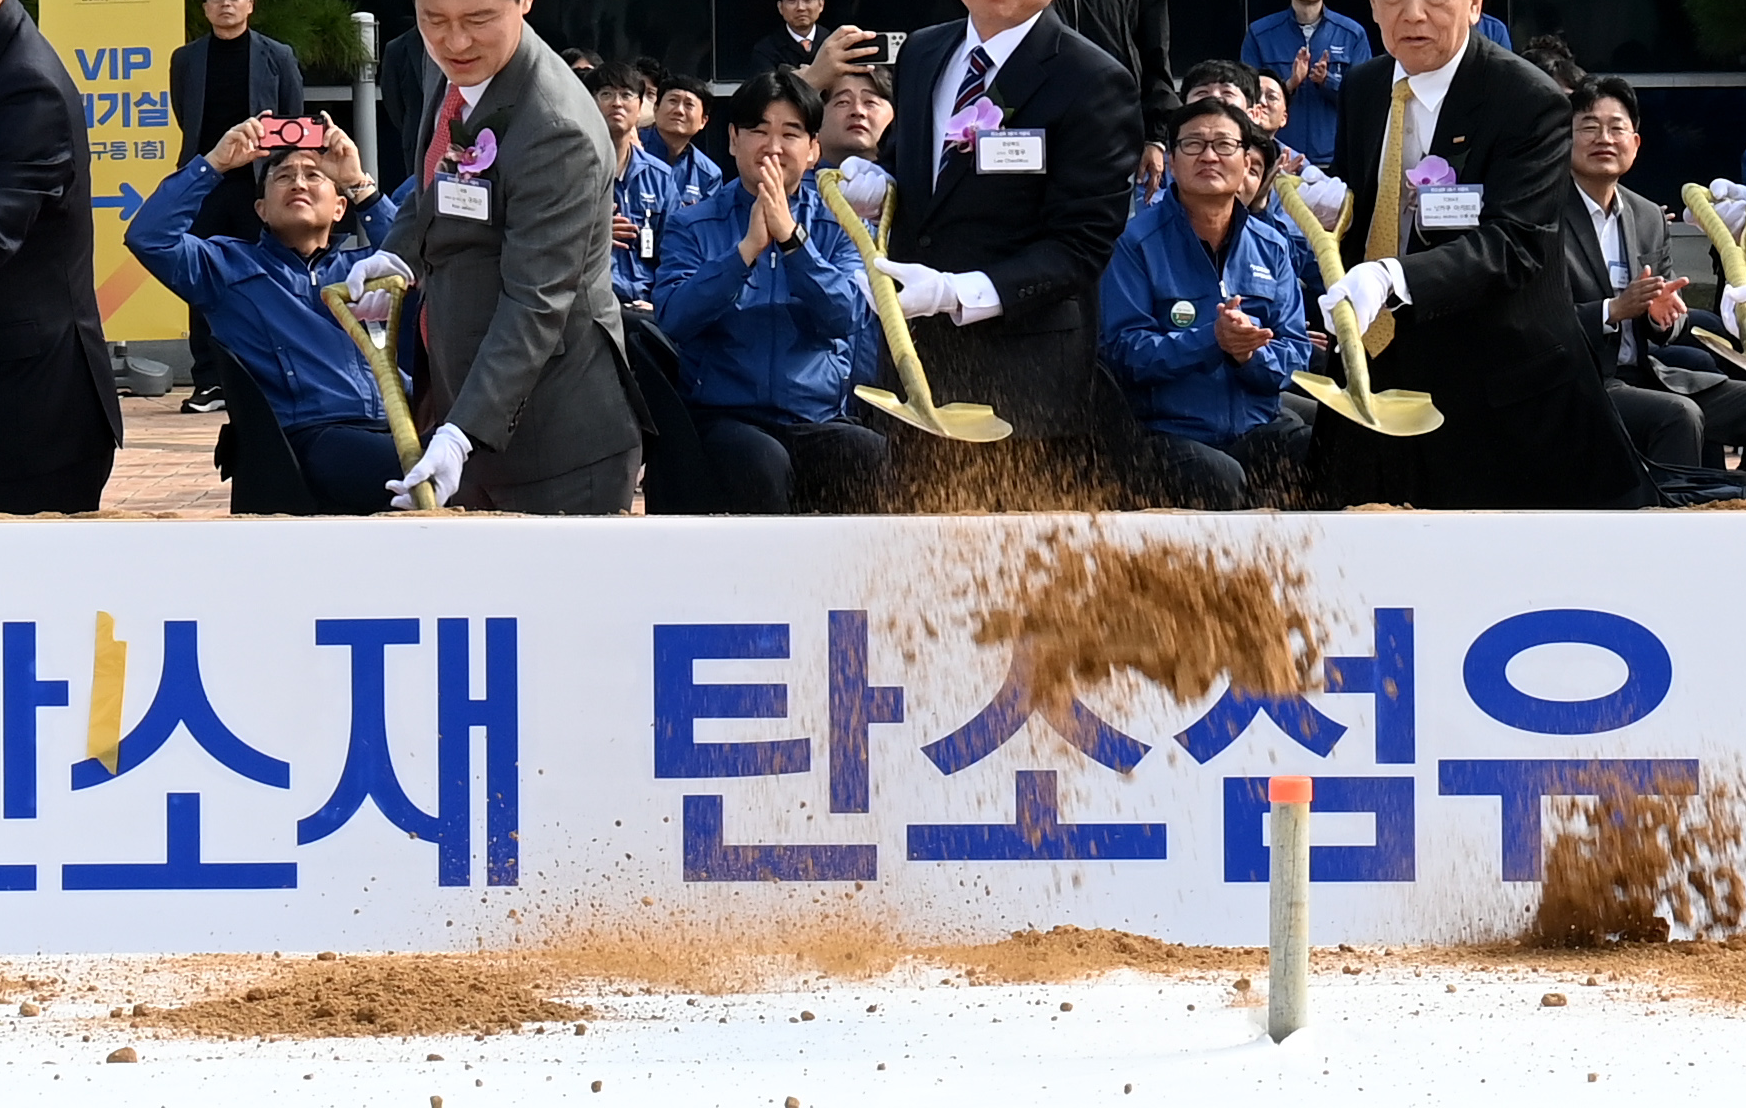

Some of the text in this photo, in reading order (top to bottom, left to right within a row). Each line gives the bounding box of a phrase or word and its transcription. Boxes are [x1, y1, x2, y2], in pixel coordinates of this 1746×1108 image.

[74, 47, 151, 80] VIP
[90, 141, 127, 160] 구동
[653, 607, 1700, 882] 탄소섬유
